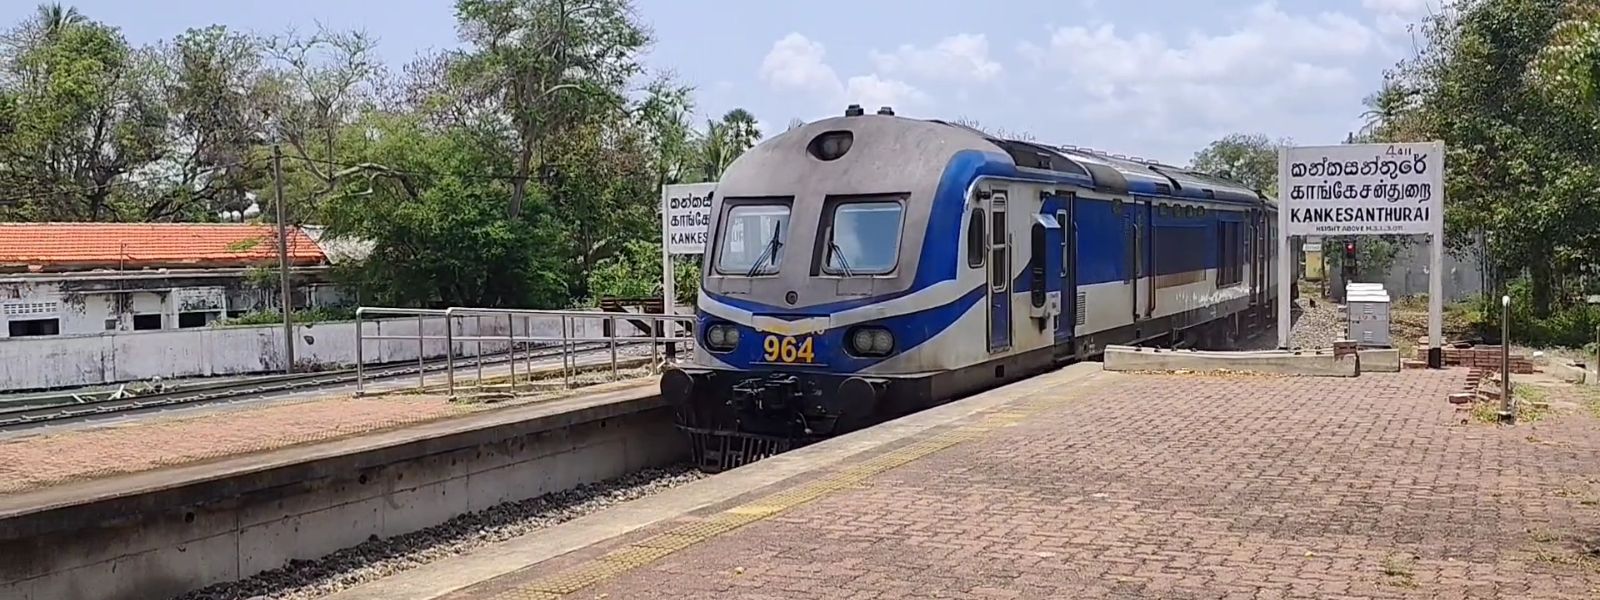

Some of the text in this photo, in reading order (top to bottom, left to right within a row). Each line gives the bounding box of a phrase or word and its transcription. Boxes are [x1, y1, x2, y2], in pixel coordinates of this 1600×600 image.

[1290, 180, 1431, 203] காங்கேசன்துறை
[1291, 207, 1429, 222] KANKESANTHURAI
[764, 335, 815, 363] 964
